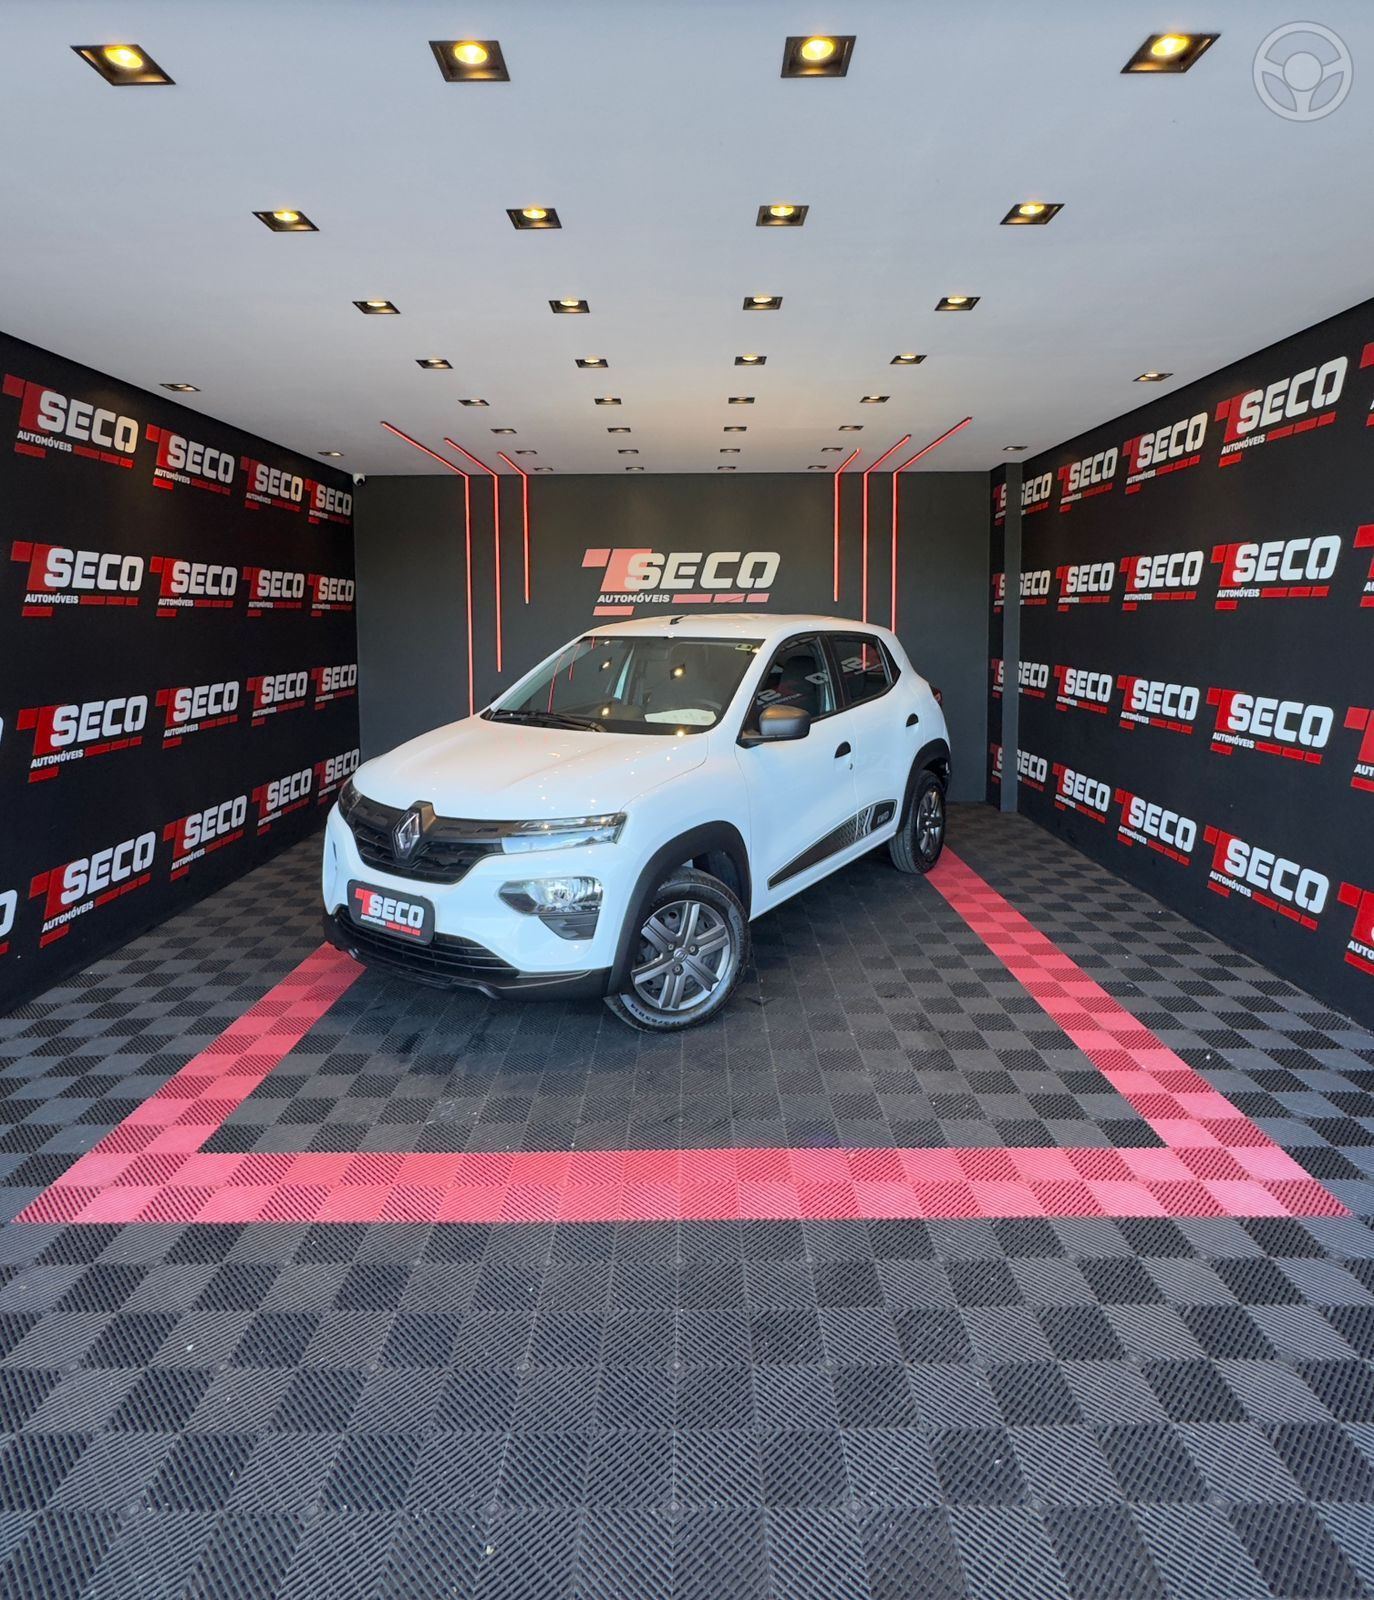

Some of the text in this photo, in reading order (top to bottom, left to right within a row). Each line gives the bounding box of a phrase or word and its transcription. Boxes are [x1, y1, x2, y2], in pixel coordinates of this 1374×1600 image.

[17, 430, 72, 453] AUTOMÓVEIS
[1221, 433, 1266, 455] AUTOMÓVEIS
[25, 592, 79, 604] AUTOMÓVEIS
[597, 592, 670, 604] AUTOMÓVEIS
[1216, 585, 1261, 598] AUTOMÓVEIS
[1212, 731, 1255, 749] AUTOMÓVEIS
[31, 749, 84, 769] AUTOMÓVEIS
[1209, 870, 1252, 898] AUTOMÓVEIS
[42, 900, 94, 933] AUTOMÓVEIS
